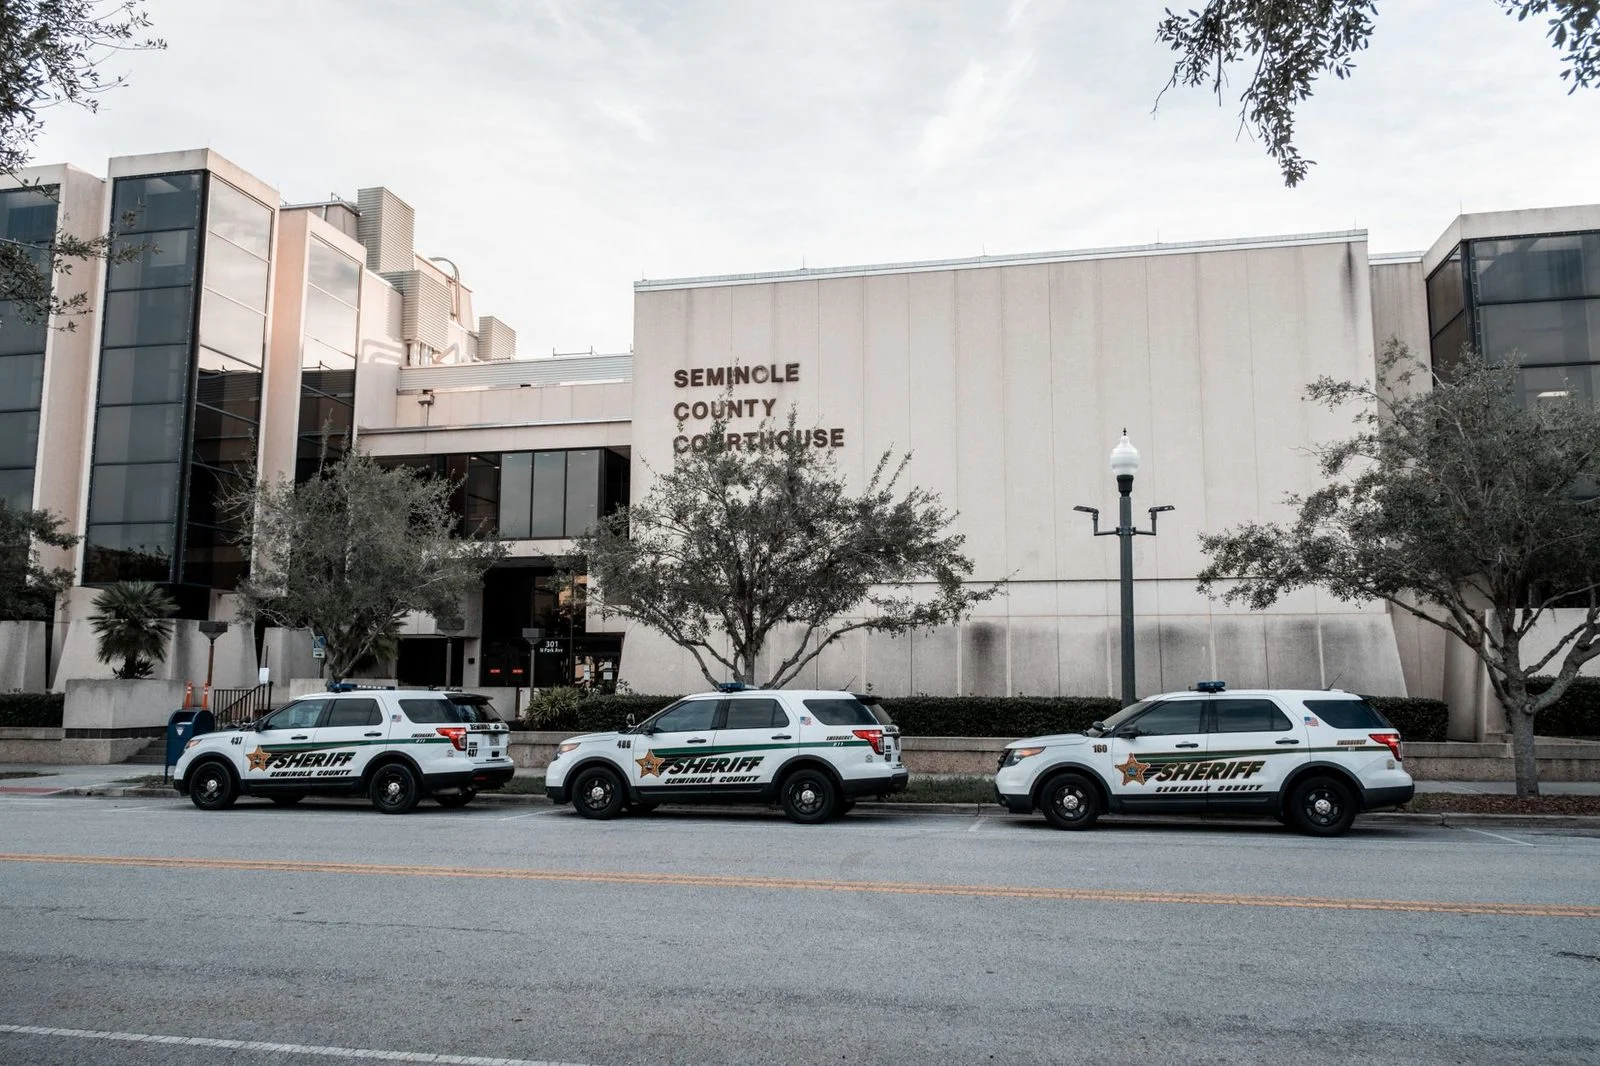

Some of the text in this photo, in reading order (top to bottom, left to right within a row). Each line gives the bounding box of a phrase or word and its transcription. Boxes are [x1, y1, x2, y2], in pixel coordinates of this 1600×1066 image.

[674, 363, 800, 388] SEMINOLE
[673, 398, 777, 421] COUNTY
[545, 640, 558, 648] 301
[230, 736, 243, 745] 437
[274, 752, 357, 769] SHERIFF
[668, 756, 765, 775] SHERIFF
[270, 769, 352, 778] SEMINOLE COUNTY
[1155, 760, 1266, 782] SHERIFF
[665, 775, 761, 785] SEMINOLE COUNTY
[1155, 784, 1263, 793] SEMINOLE COUNTY
